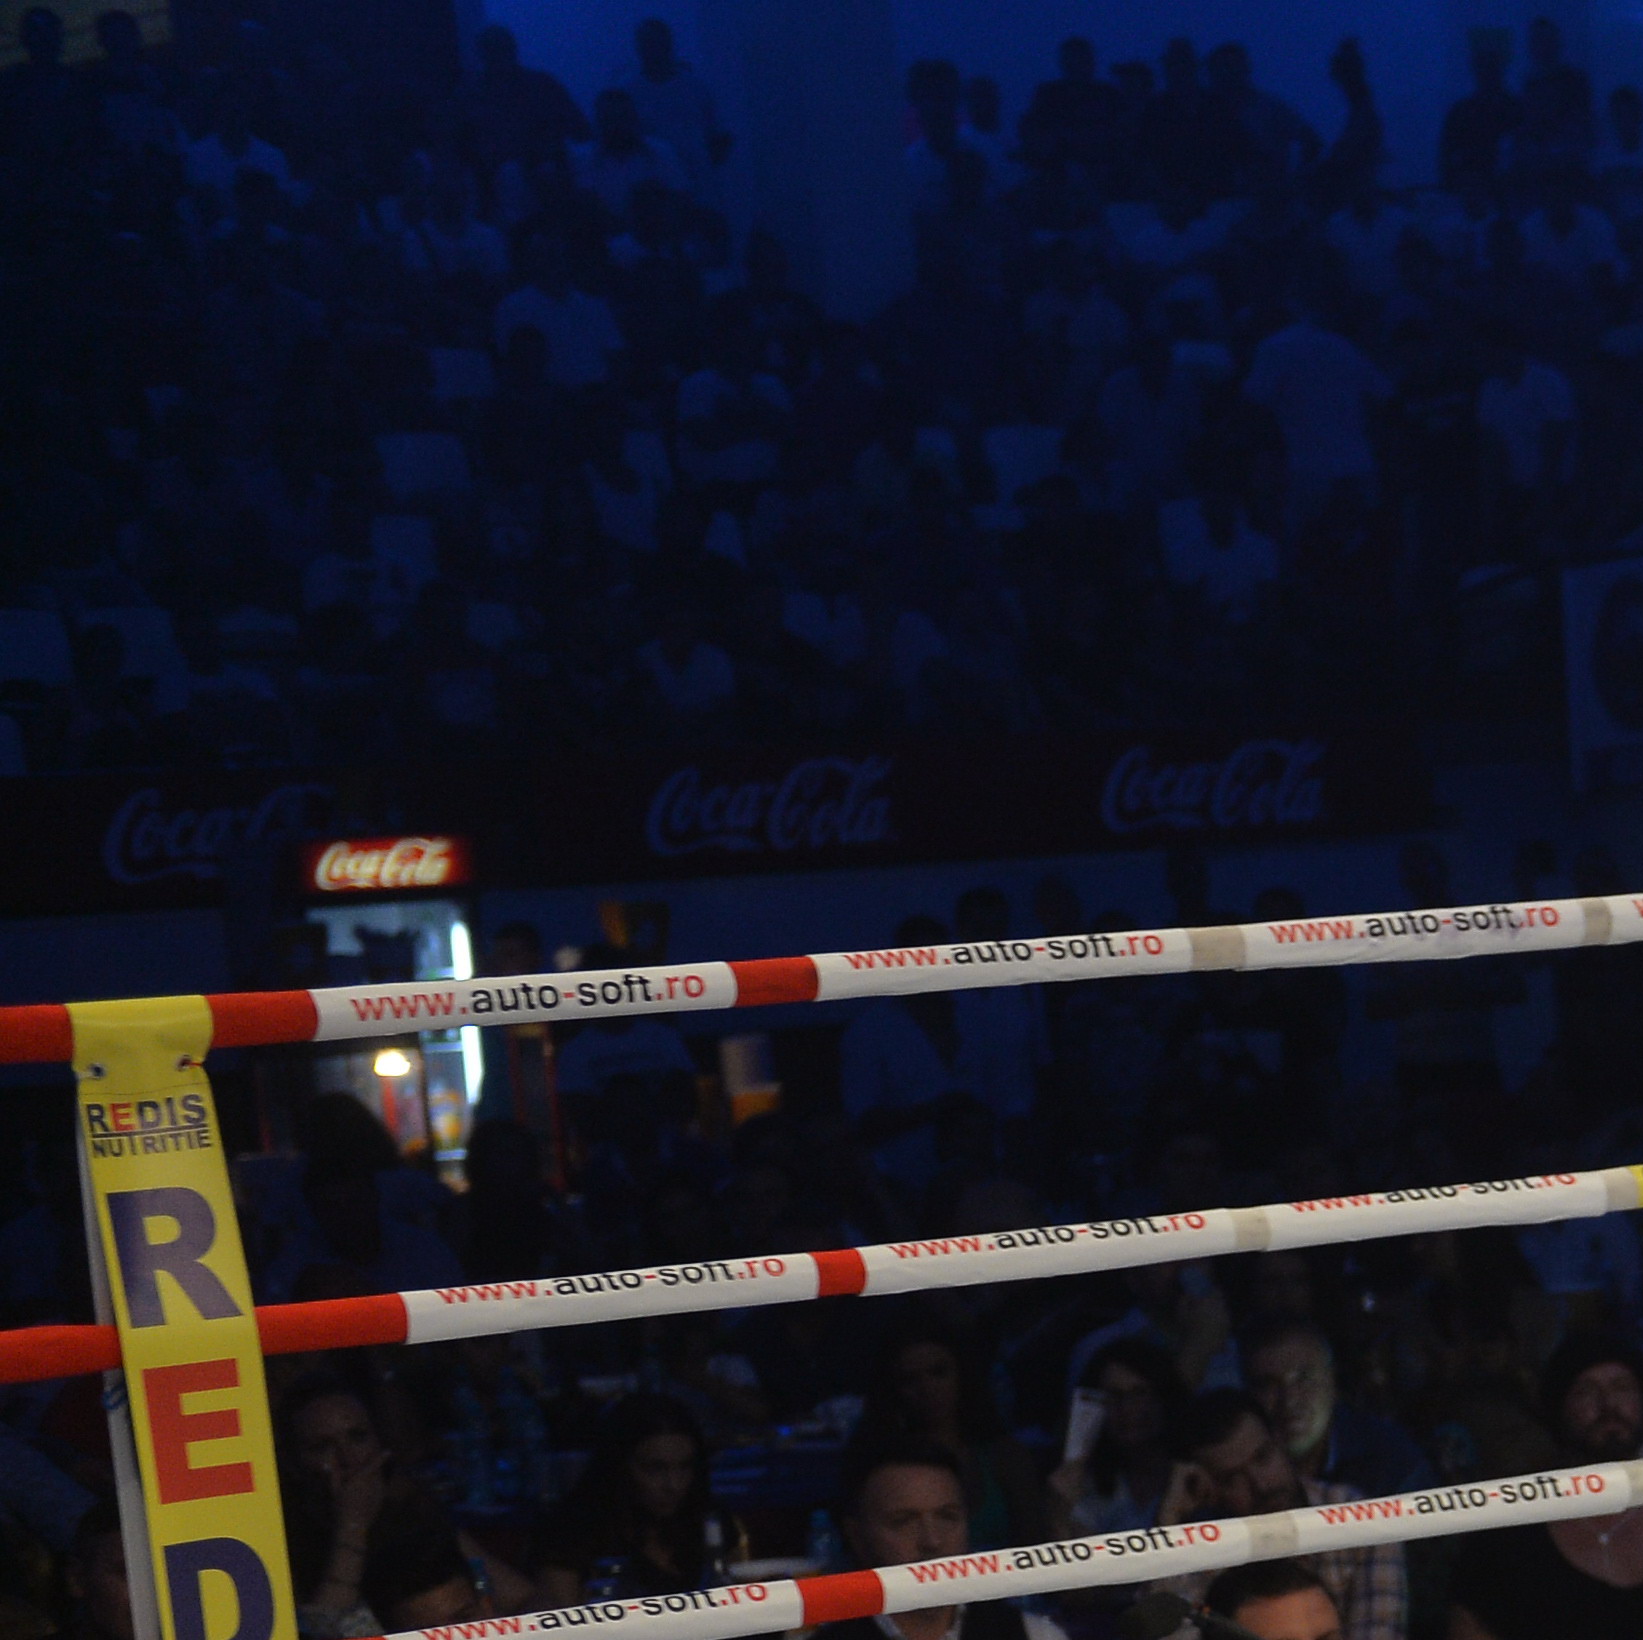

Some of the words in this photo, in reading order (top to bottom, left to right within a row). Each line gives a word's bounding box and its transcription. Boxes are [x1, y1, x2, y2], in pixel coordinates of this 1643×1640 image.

[1268, 905, 1561, 944] www.auto-soft.ro
[842, 933, 1165, 970] www.auto-soft.ro
[350, 973, 706, 1022] www.auto-soft.ro
[80, 1093, 207, 1135] REDIS
[92, 1130, 213, 1159] NUTRITIE
[889, 1213, 1206, 1260] www.auto-soft.ro
[434, 1257, 786, 1305] www.auto-soft.ro
[1316, 1475, 1607, 1526] www.auto-soft.ro
[907, 1523, 1222, 1584] www.auto-soft.ro
